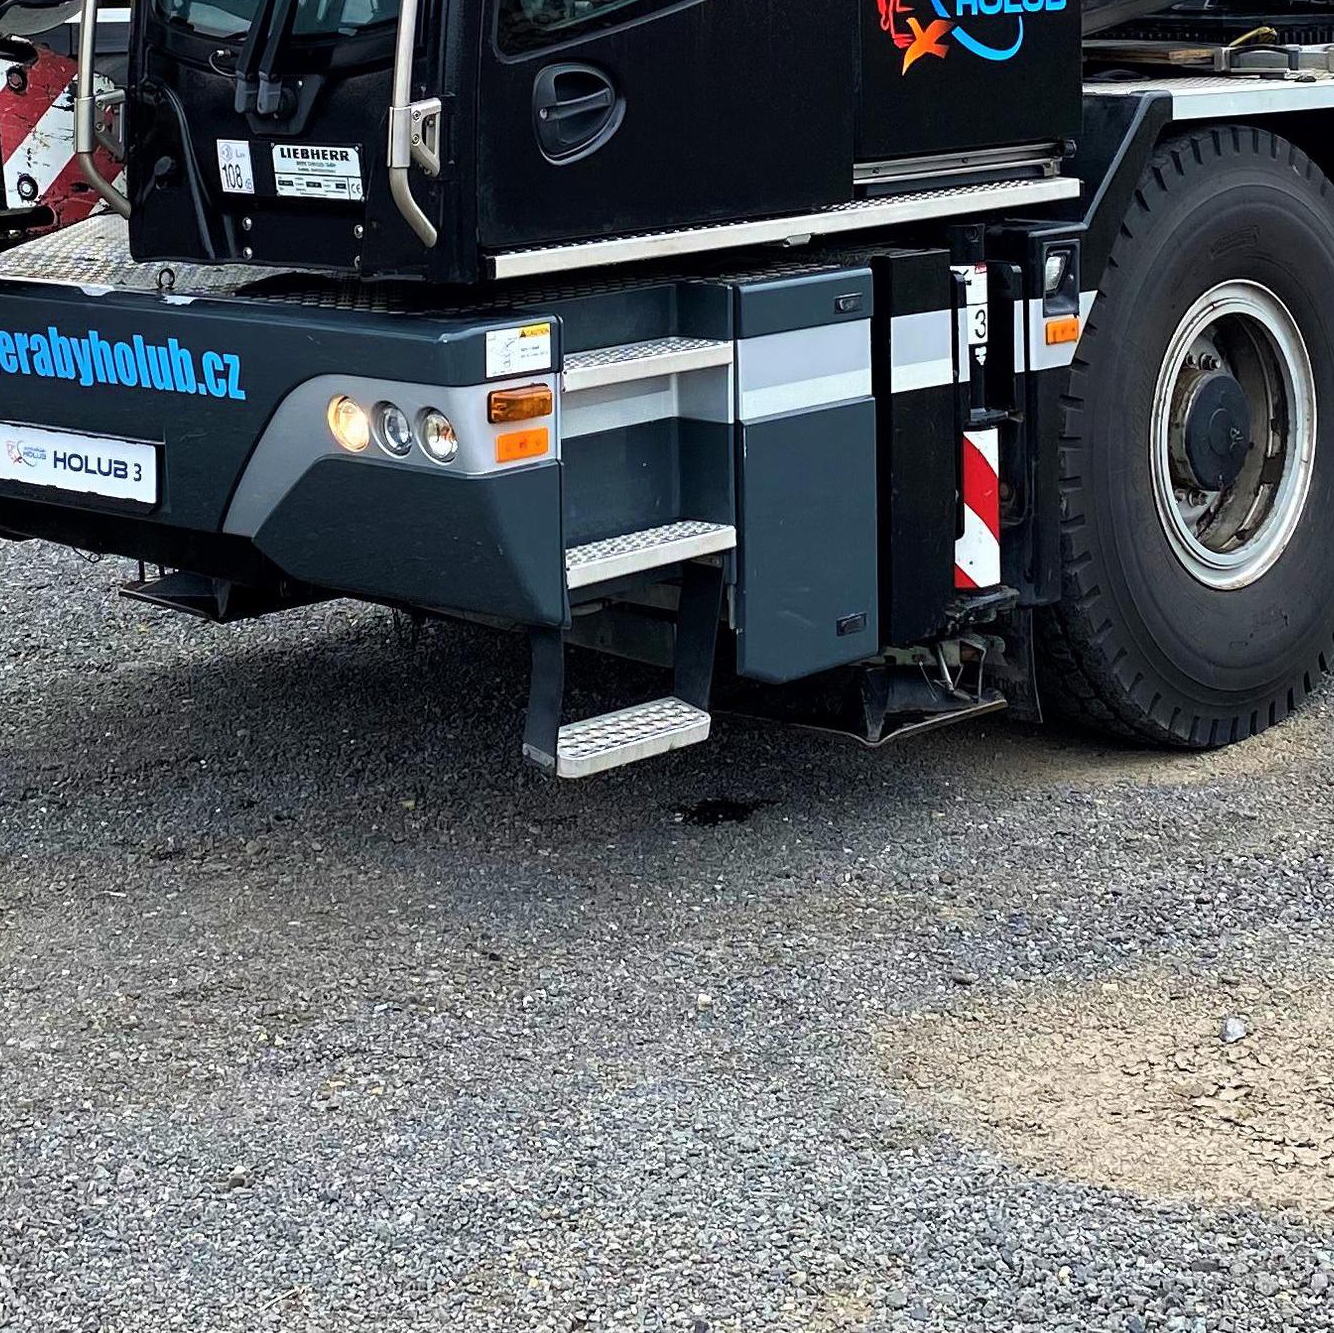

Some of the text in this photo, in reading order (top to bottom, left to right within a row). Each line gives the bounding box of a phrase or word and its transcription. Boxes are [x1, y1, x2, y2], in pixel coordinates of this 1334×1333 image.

[280, 147, 351, 162] LIEBHERR
[222, 164, 243, 189] 108
[974, 309, 987, 339] 3
[53, 450, 142, 482] HOLUB 3
